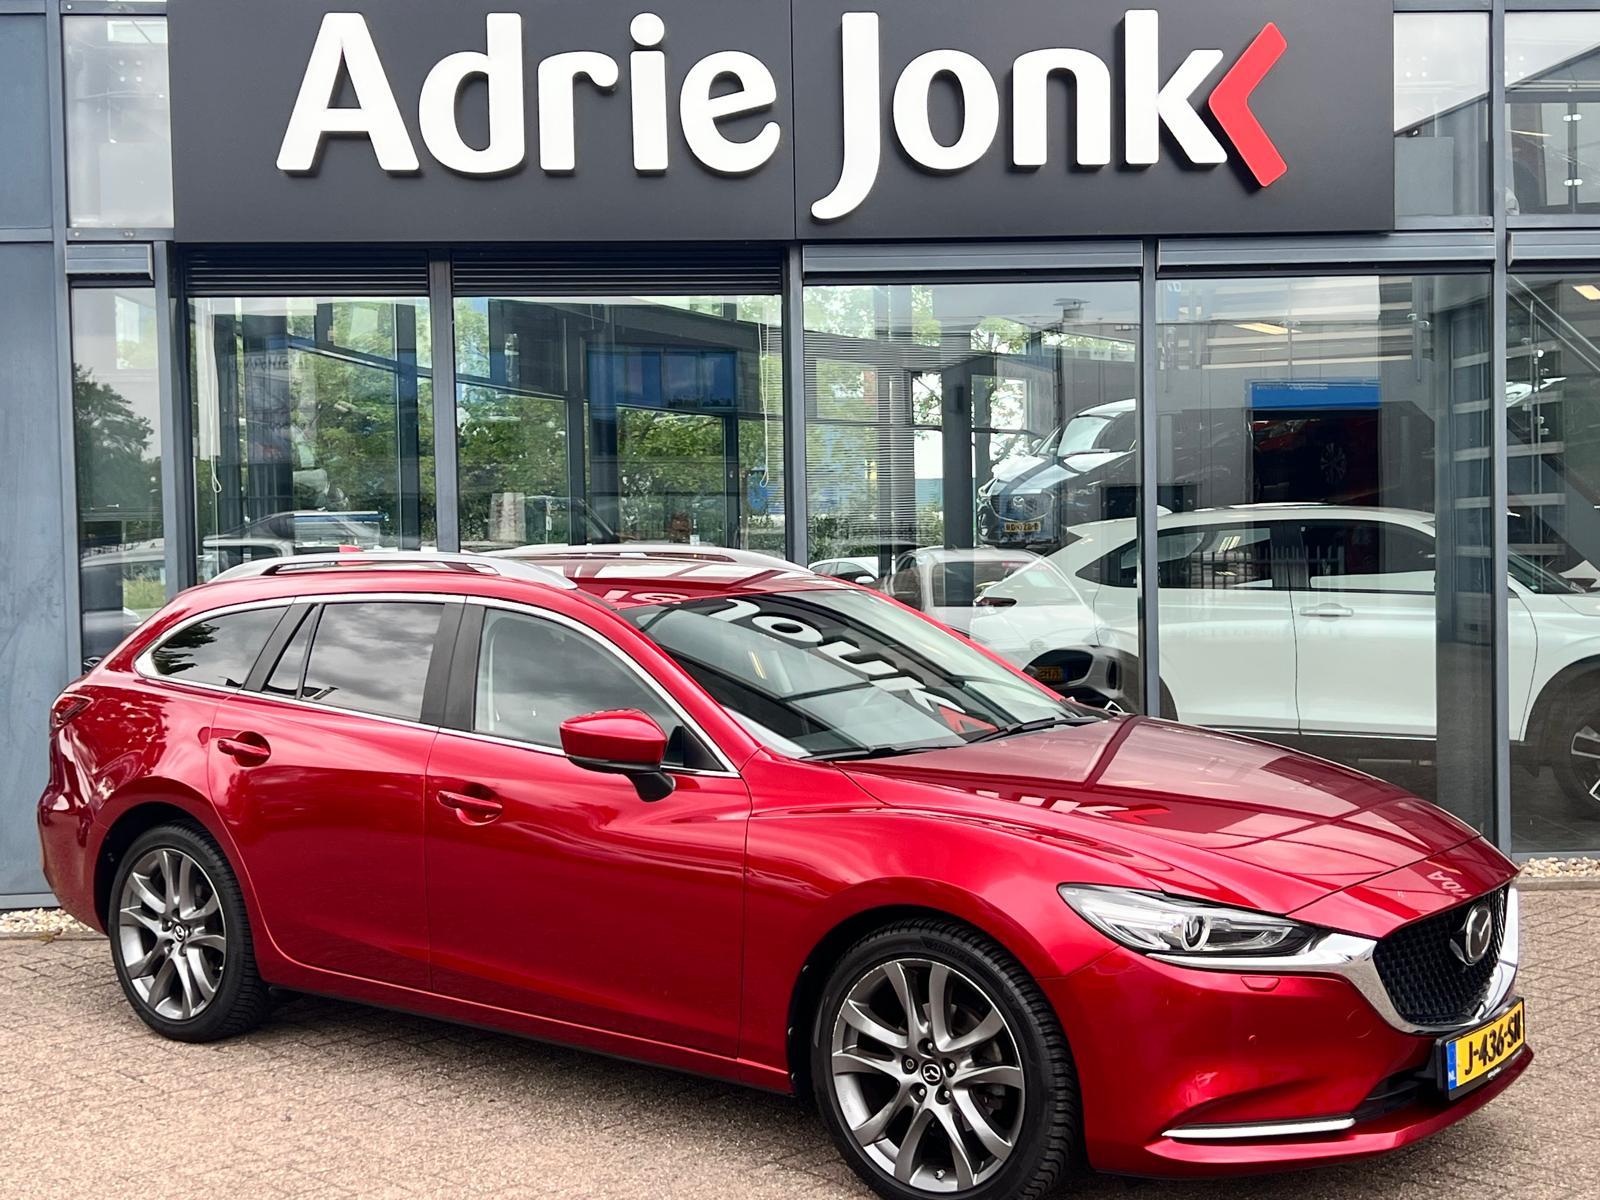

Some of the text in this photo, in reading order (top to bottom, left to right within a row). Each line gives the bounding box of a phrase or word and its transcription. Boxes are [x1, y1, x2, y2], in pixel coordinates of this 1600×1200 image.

[276, 9, 1228, 220] Adrie Jonk
[1464, 1009, 1521, 1076] J-436-SN
